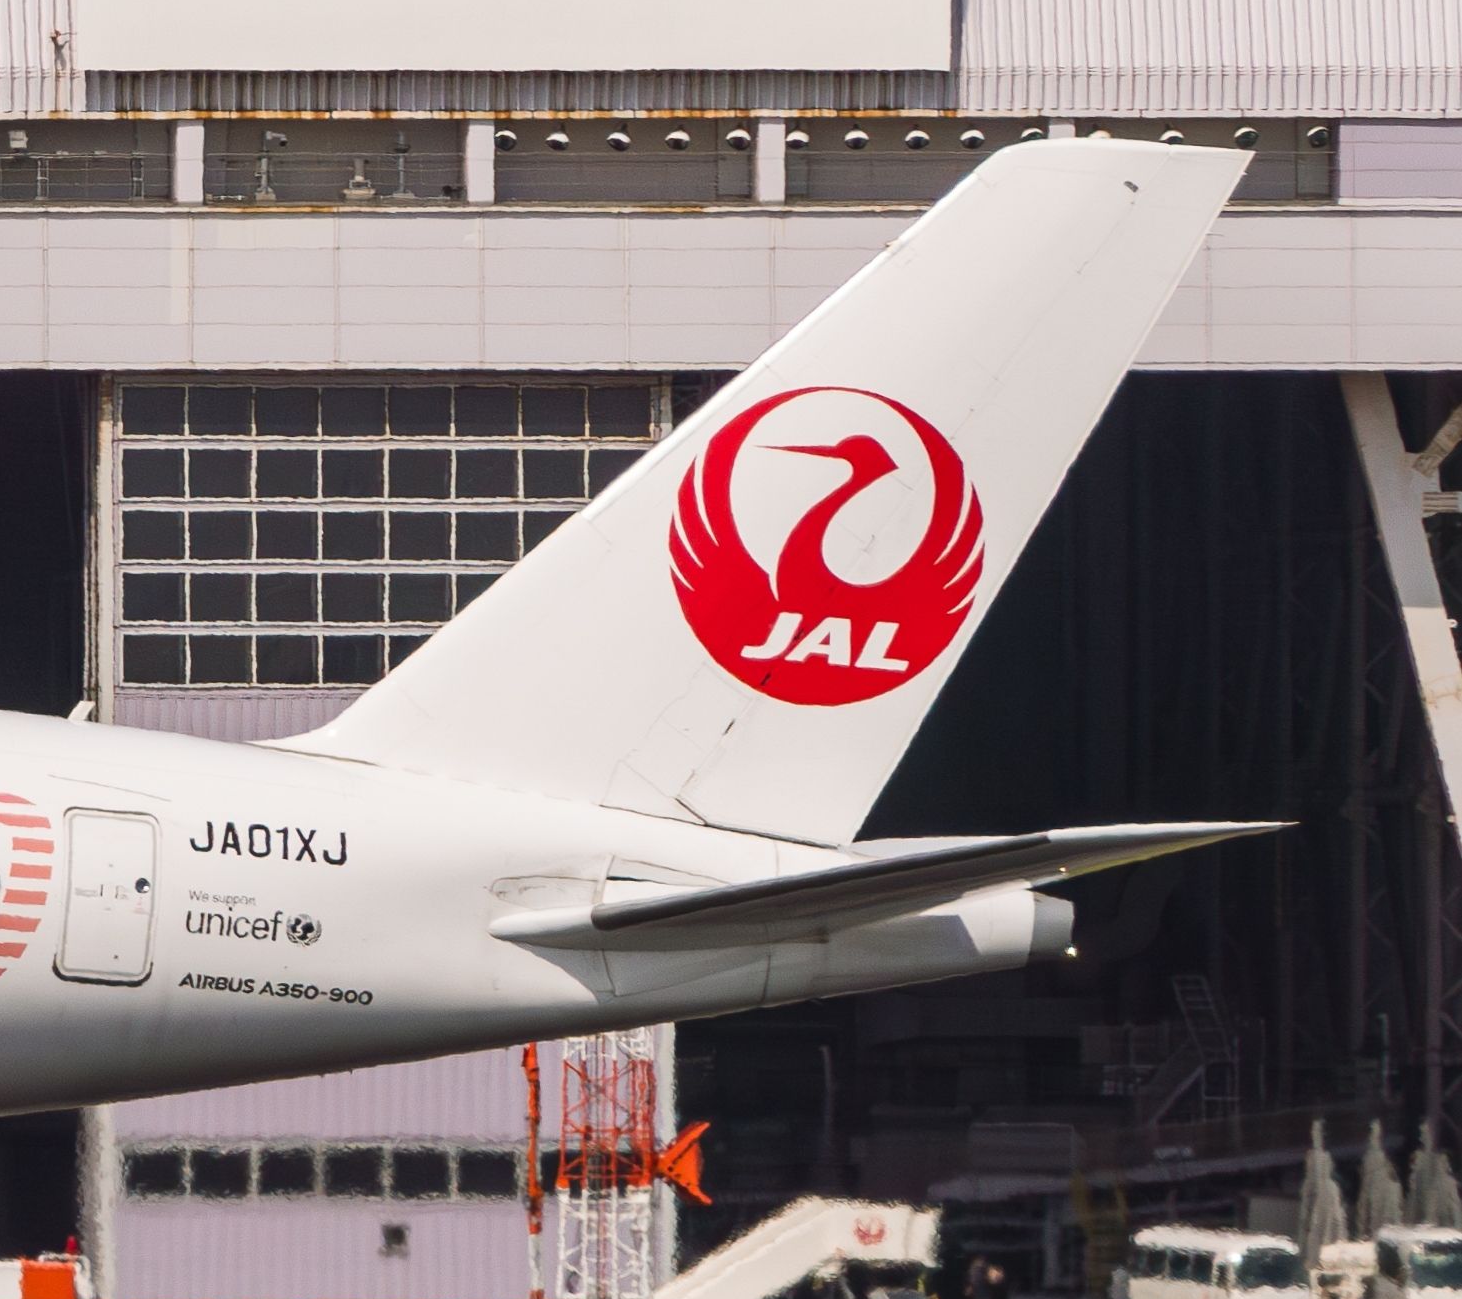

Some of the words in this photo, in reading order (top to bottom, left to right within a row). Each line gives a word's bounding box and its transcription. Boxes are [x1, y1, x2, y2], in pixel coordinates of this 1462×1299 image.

[741, 612, 909, 672] JAL
[189, 821, 348, 866] JA01XJ
[188, 890, 210, 902] We
[185, 906, 284, 942] unicef
[178, 972, 256, 995] AIRBUS
[258, 981, 374, 1006] A350-900
